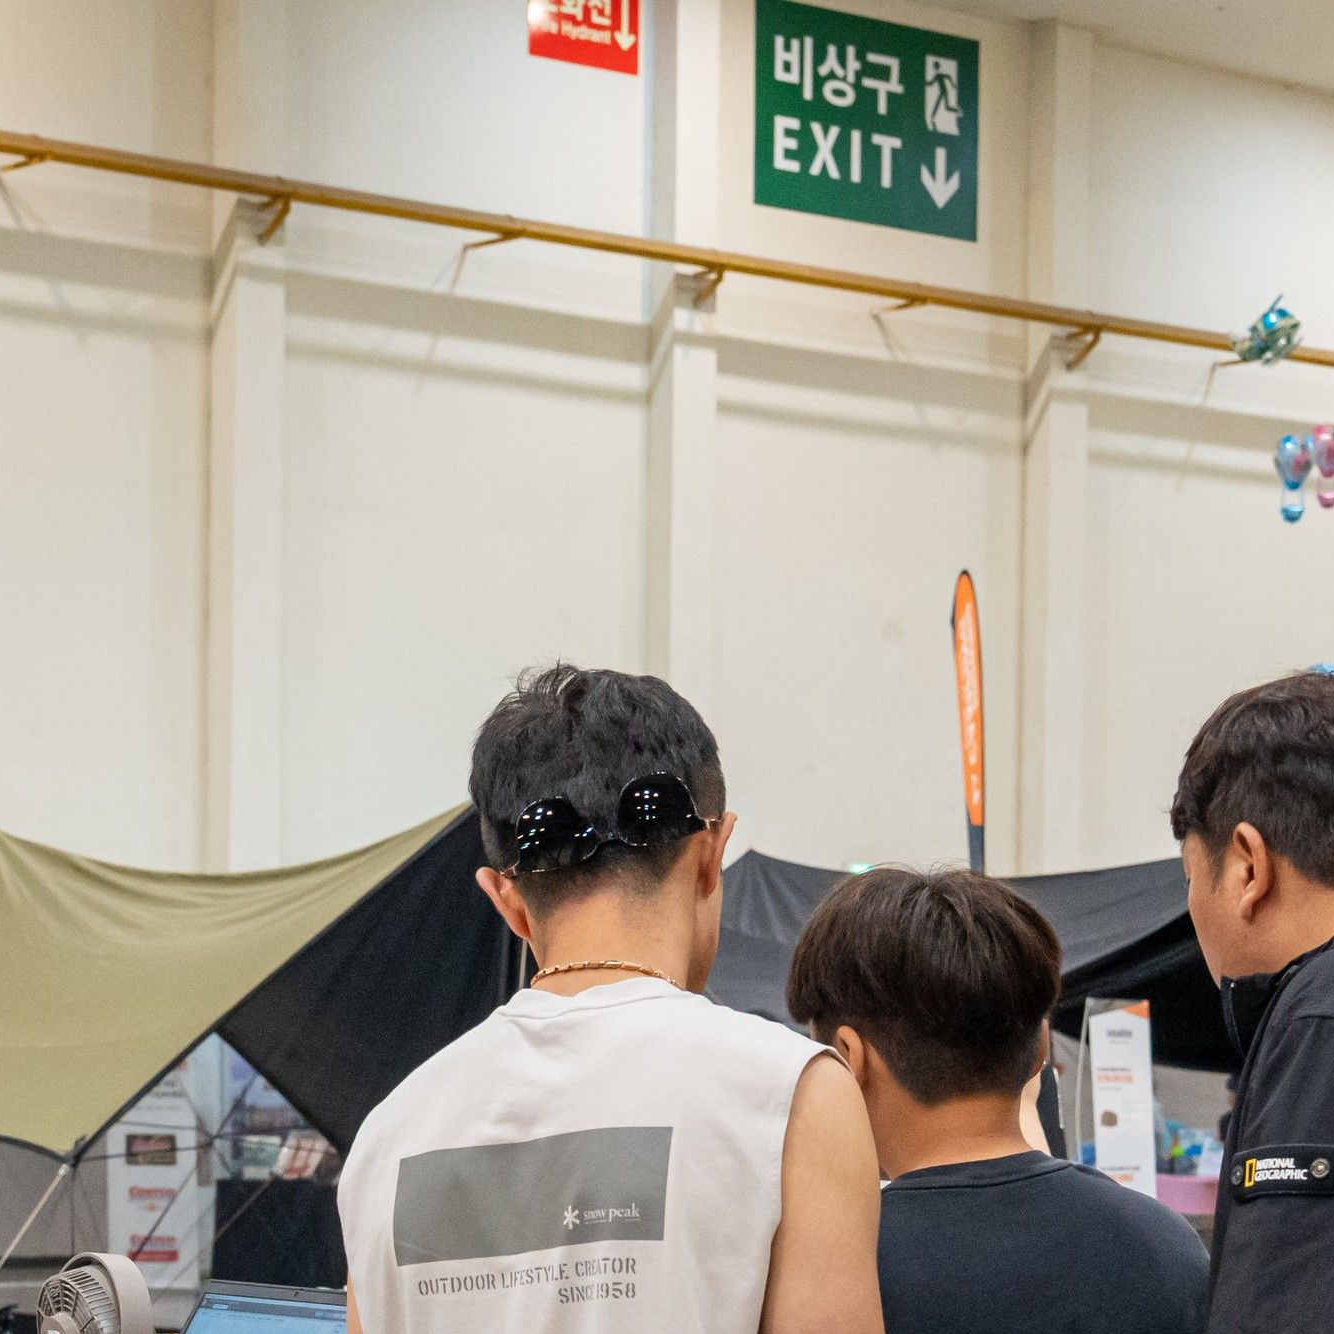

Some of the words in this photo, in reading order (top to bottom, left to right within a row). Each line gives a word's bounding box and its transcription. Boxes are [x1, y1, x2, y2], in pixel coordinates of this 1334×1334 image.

[773, 35, 905, 115] 비상구
[773, 115, 903, 189] EXIT
[1256, 1158, 1296, 1170] NATIONAL
[1255, 1169, 1308, 1181] GEOGRAPHIC
[584, 1209, 607, 1220] snow
[609, 1203, 640, 1222] peak
[418, 1273, 496, 1296] OUTDOOR
[500, 1263, 569, 1289] LIFESTYLE
[575, 1257, 637, 1278] CREATOR
[595, 1282, 637, 1300] 1958
